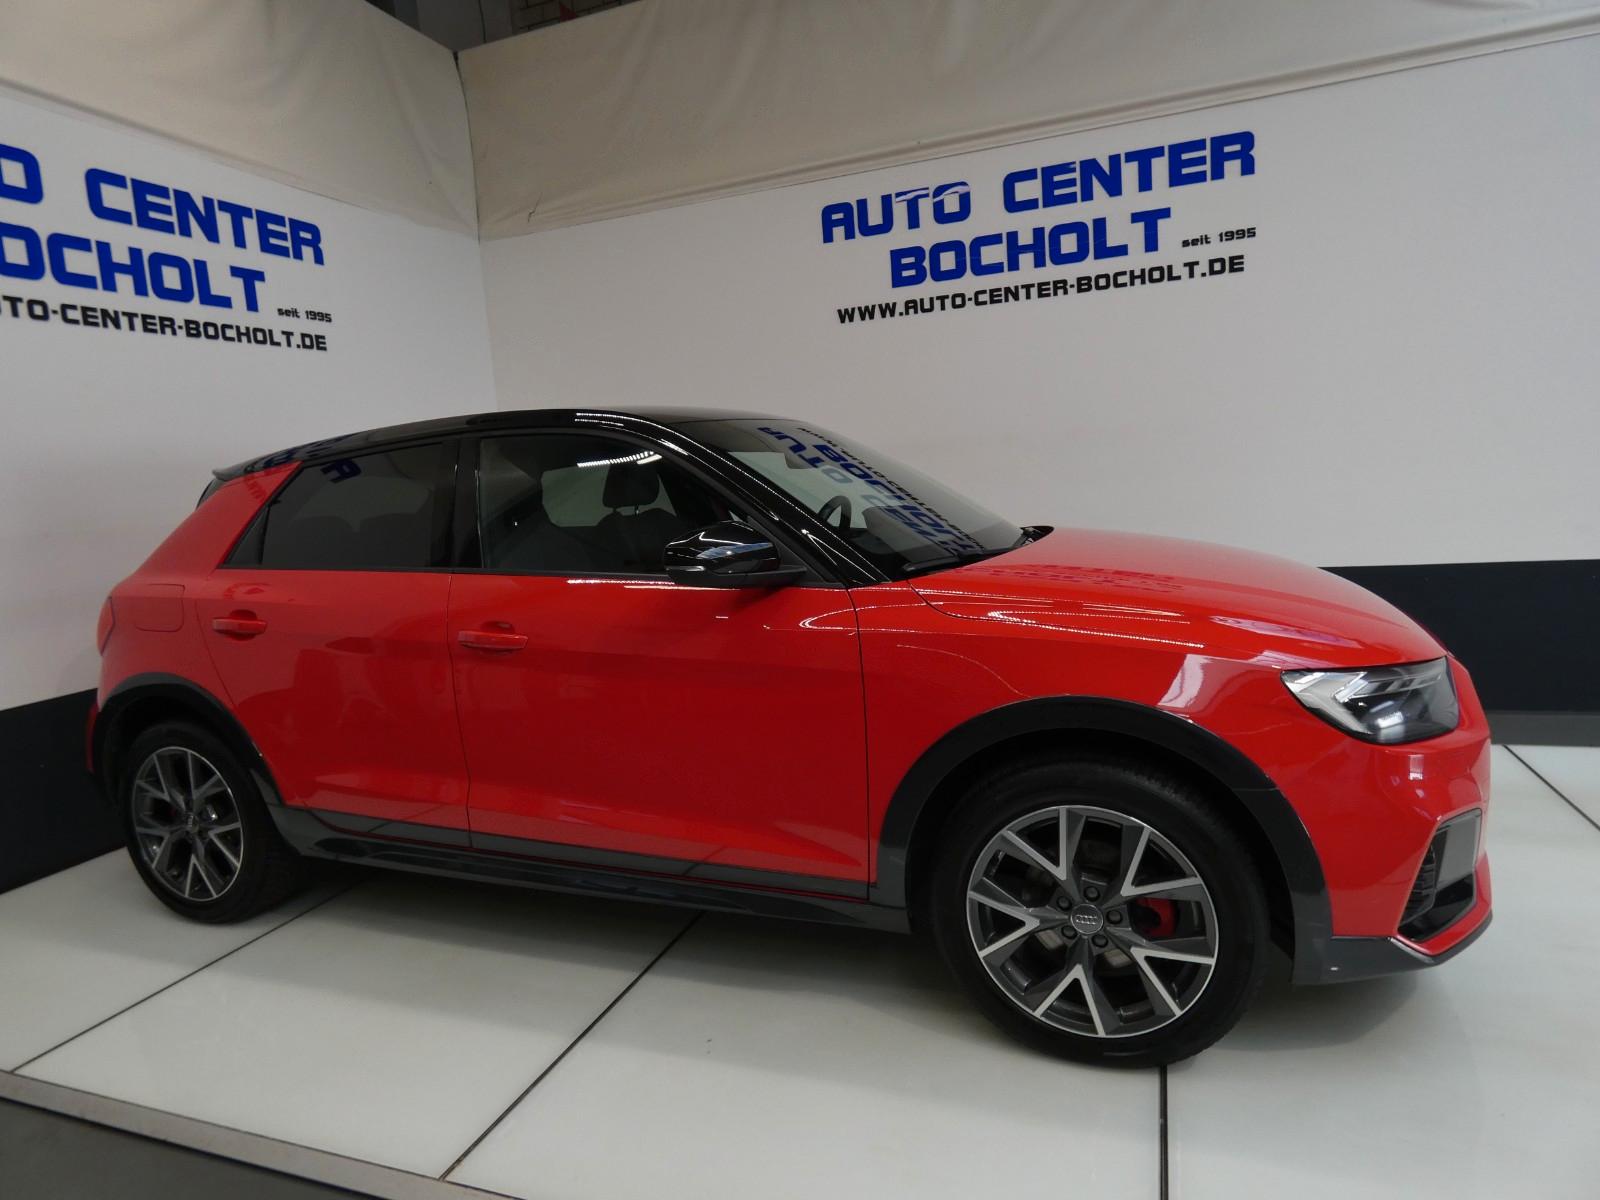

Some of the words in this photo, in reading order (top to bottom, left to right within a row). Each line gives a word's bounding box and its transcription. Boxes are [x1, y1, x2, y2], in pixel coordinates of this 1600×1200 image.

[85, 167, 325, 266] CENTER
[822, 181, 971, 244] AUTO
[1003, 131, 1256, 214] CENTER
[890, 207, 1172, 289] BOCHOLT
[1181, 233, 1212, 248] seit
[1218, 226, 1257, 243] 1995
[0, 294, 328, 352] TO-CENTER-BOCHOLT.DE
[277, 306, 301, 319] seit
[304, 310, 333, 323] 1995
[836, 254, 1246, 324] WWW.AUTO-CENTER-BOCHOLT.DE
